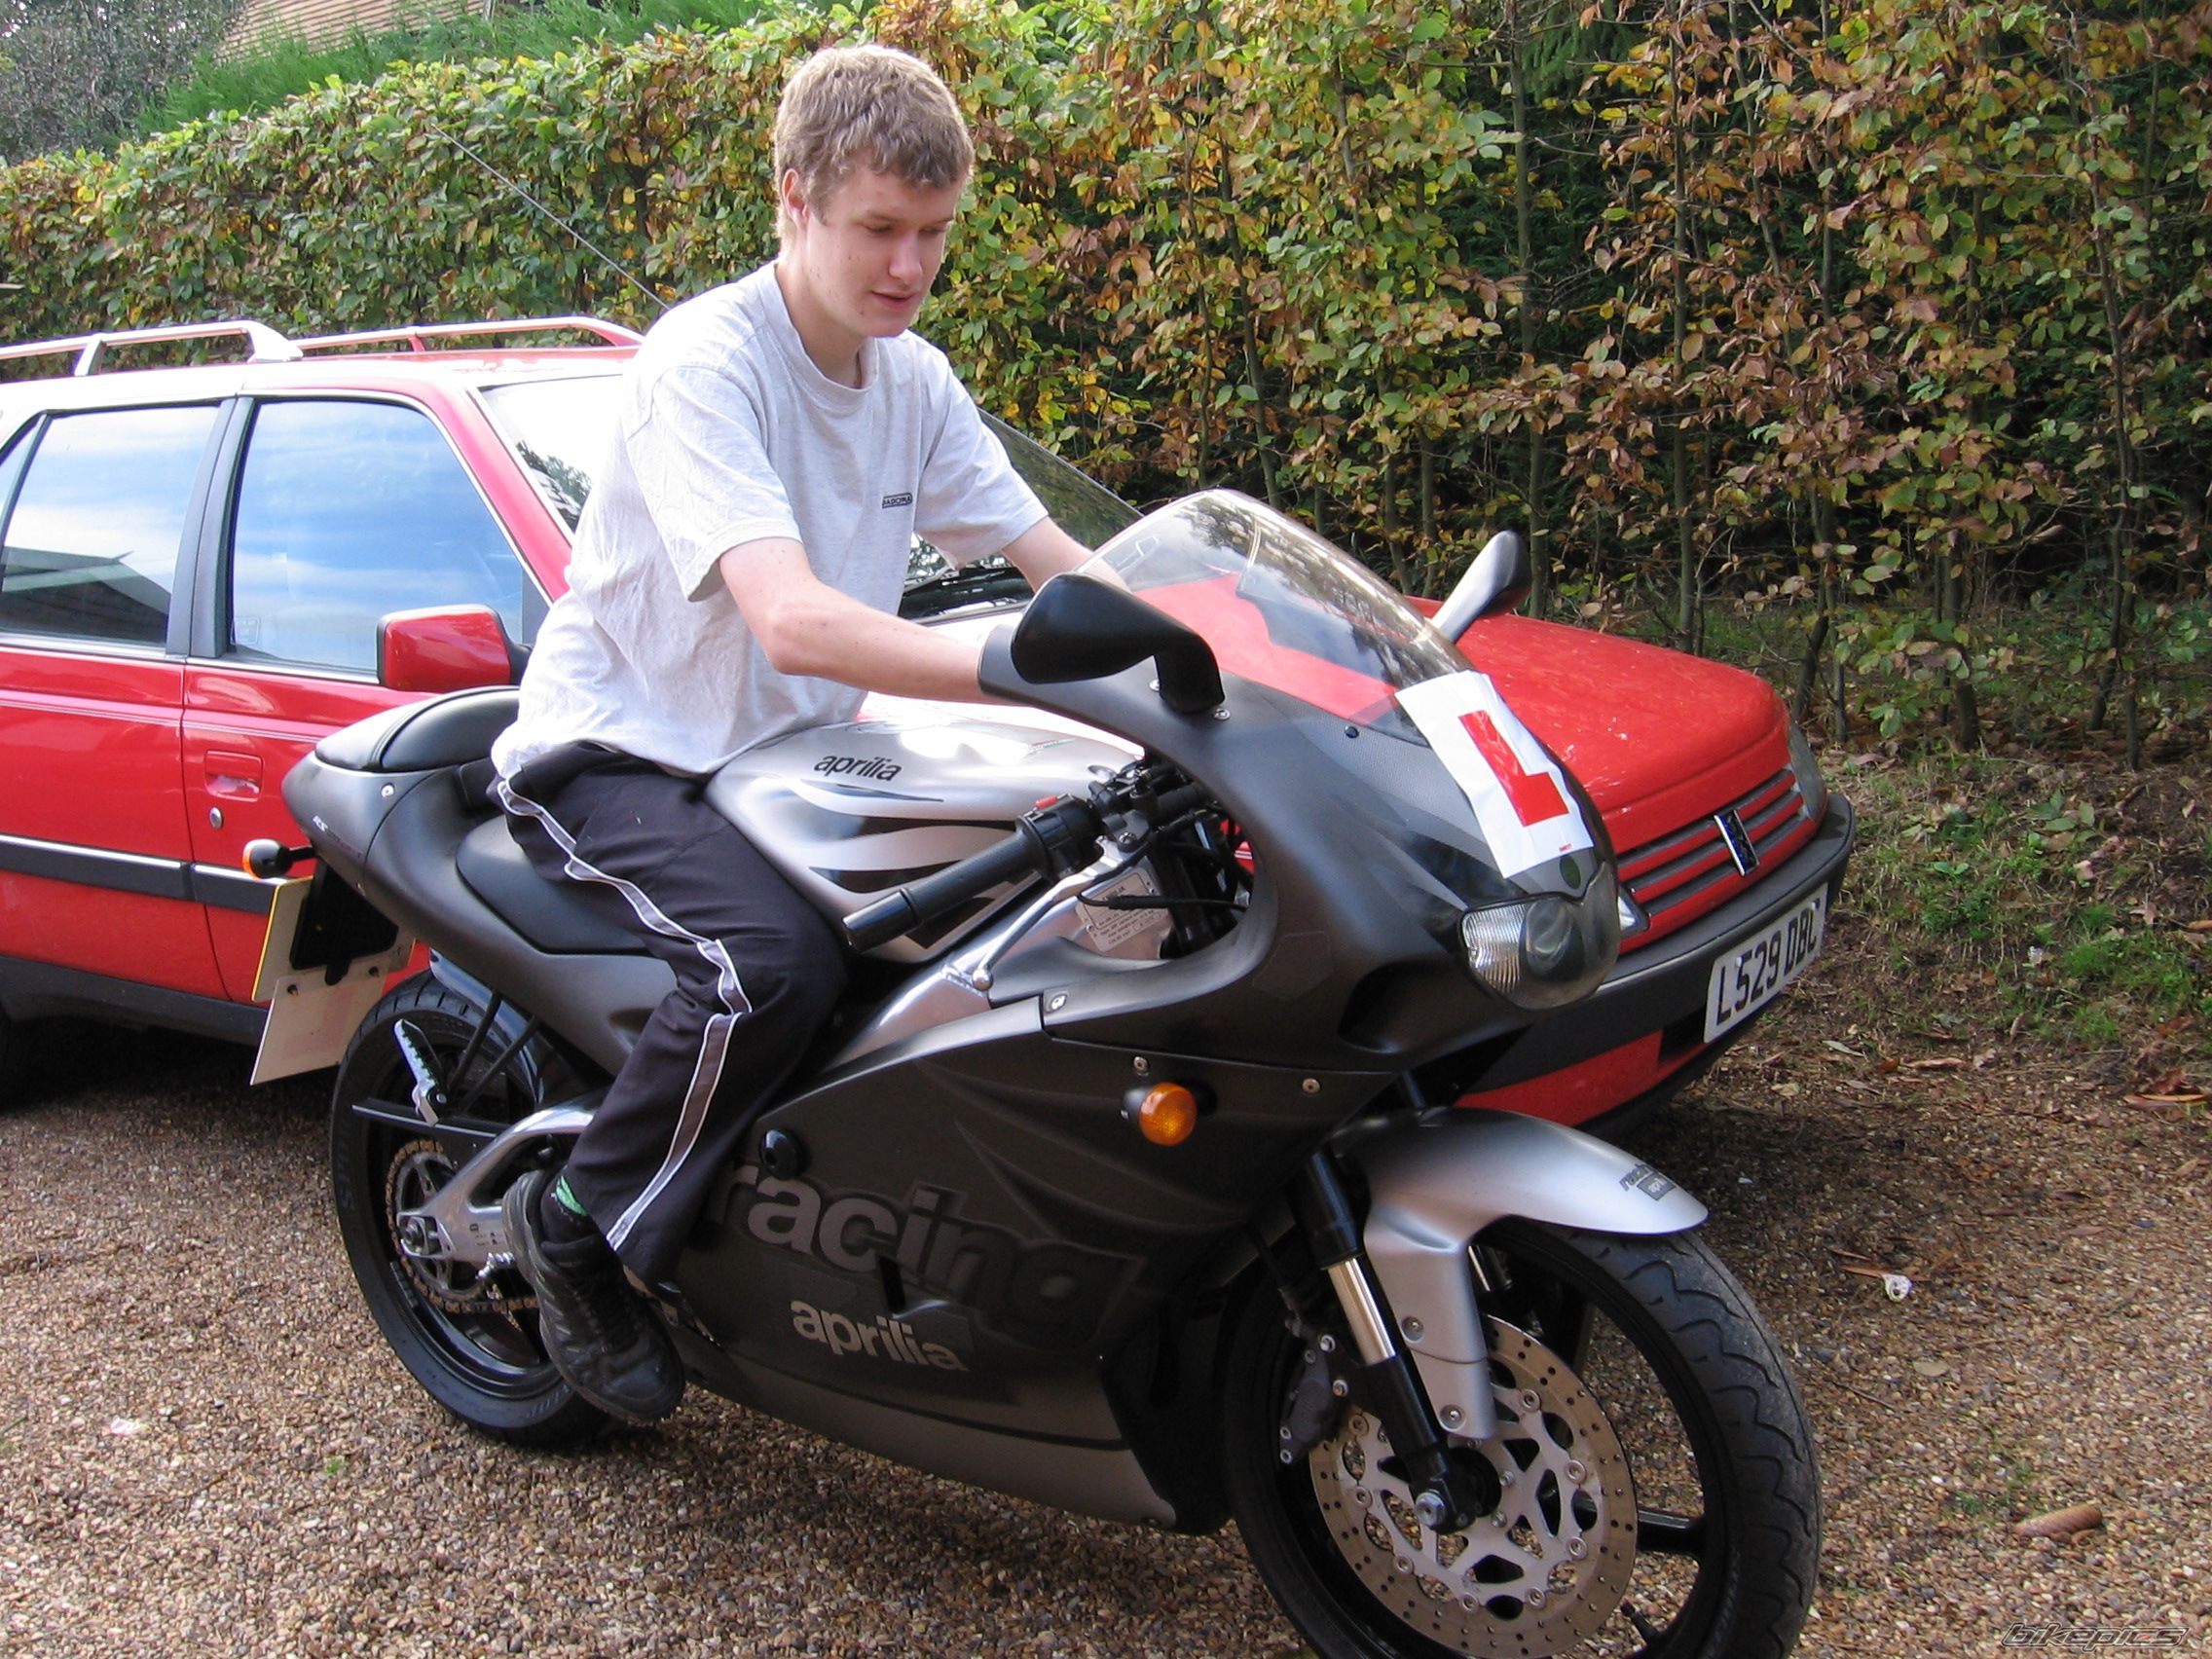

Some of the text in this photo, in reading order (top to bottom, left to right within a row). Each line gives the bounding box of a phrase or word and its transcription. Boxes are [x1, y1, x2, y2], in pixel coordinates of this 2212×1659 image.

[814, 756, 903, 781] aprilia
[1457, 710, 1569, 828] L
[1716, 898, 1821, 1026] L529 DBC
[790, 1300, 969, 1373] aprilia
